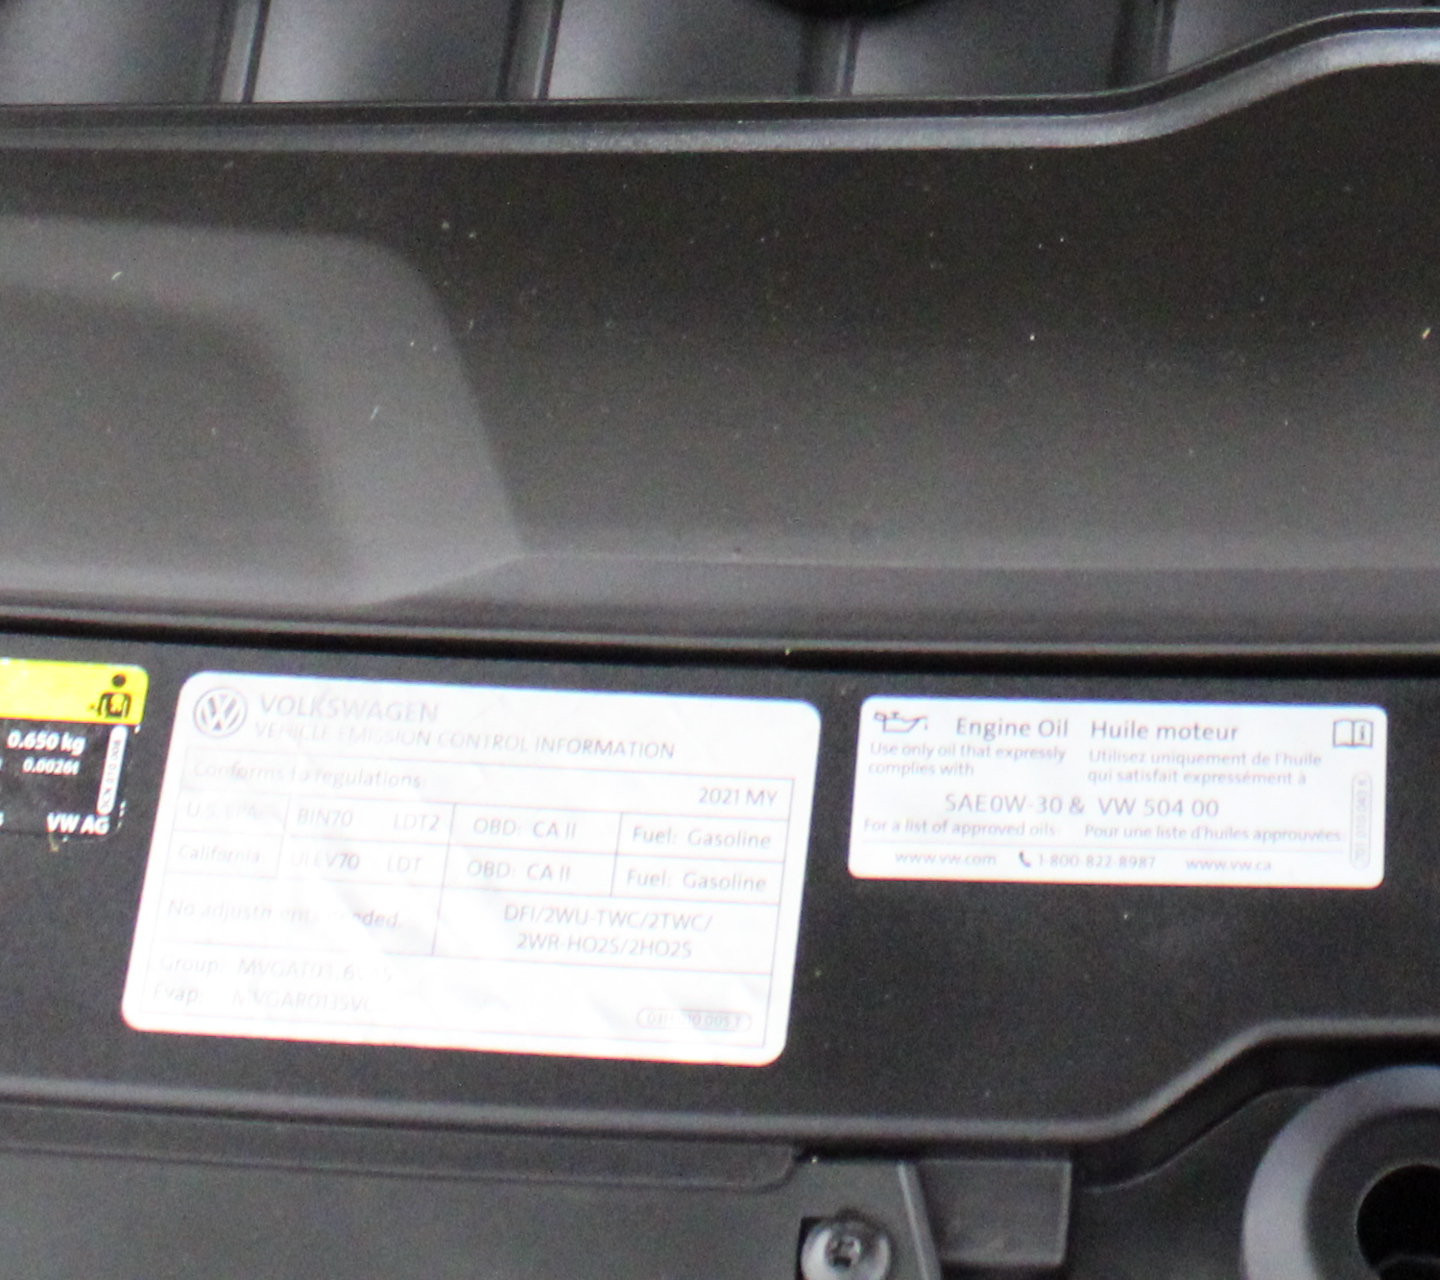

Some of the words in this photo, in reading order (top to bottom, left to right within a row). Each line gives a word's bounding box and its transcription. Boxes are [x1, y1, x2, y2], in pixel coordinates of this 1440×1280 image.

[259, 693, 440, 723] VOLKSWAGEN
[955, 716, 1032, 741] Engine
[1037, 717, 1069, 738] Oil
[1090, 719, 1149, 741] Huile
[1156, 721, 1239, 742] moteur
[6, 729, 59, 751] 0.650
[61, 735, 86, 756] kg
[437, 731, 528, 753] CONTROL
[534, 734, 677, 760] INFORMATION
[870, 742, 898, 757] Use
[901, 743, 934, 761] only
[936, 743, 956, 759] oil
[960, 743, 992, 760] that
[995, 746, 1067, 765] expressly
[867, 762, 936, 777] complies
[939, 762, 975, 776] with
[1088, 748, 1145, 765] Utilisez
[1150, 750, 1247, 768] uniquement
[1251, 751, 1271, 767] de
[1087, 768, 1112, 786] qui
[1116, 769, 1178, 785] satisfait
[697, 785, 740, 806] 2021
[745, 788, 779, 807] MY
[1067, 794, 1086, 815] &
[1097, 796, 1137, 816] VW
[1143, 798, 1184, 818] 504
[1191, 799, 1220, 818] 00
[46, 813, 79, 833] VW
[81, 815, 110, 835] AG
[297, 807, 354, 827] BIN70
[392, 812, 441, 831] LDT2
[532, 819, 559, 839] CA
[631, 825, 677, 845] Fuel:
[687, 827, 772, 850] Gasoline
[863, 817, 889, 833] For
[892, 820, 901, 833] a
[904, 818, 928, 833] list
[931, 818, 949, 834] of
[951, 821, 1026, 839] approved
[1084, 824, 1119, 840] Pour
[1122, 826, 1152, 840] une
[1155, 826, 1187, 840] liste
[386, 855, 424, 874] LDT
[526, 861, 553, 882] CA
[626, 868, 672, 889] Fuel:
[682, 870, 767, 893] Gasoline
[894, 852, 997, 867] www.vw.com
[1184, 857, 1272, 873] www.vw.ca
[168, 899, 195, 918] No
[503, 902, 714, 933] DFI/2WU-TWC/2TWC/
[515, 932, 693, 960] 2WR-HO2S/2HO2S
